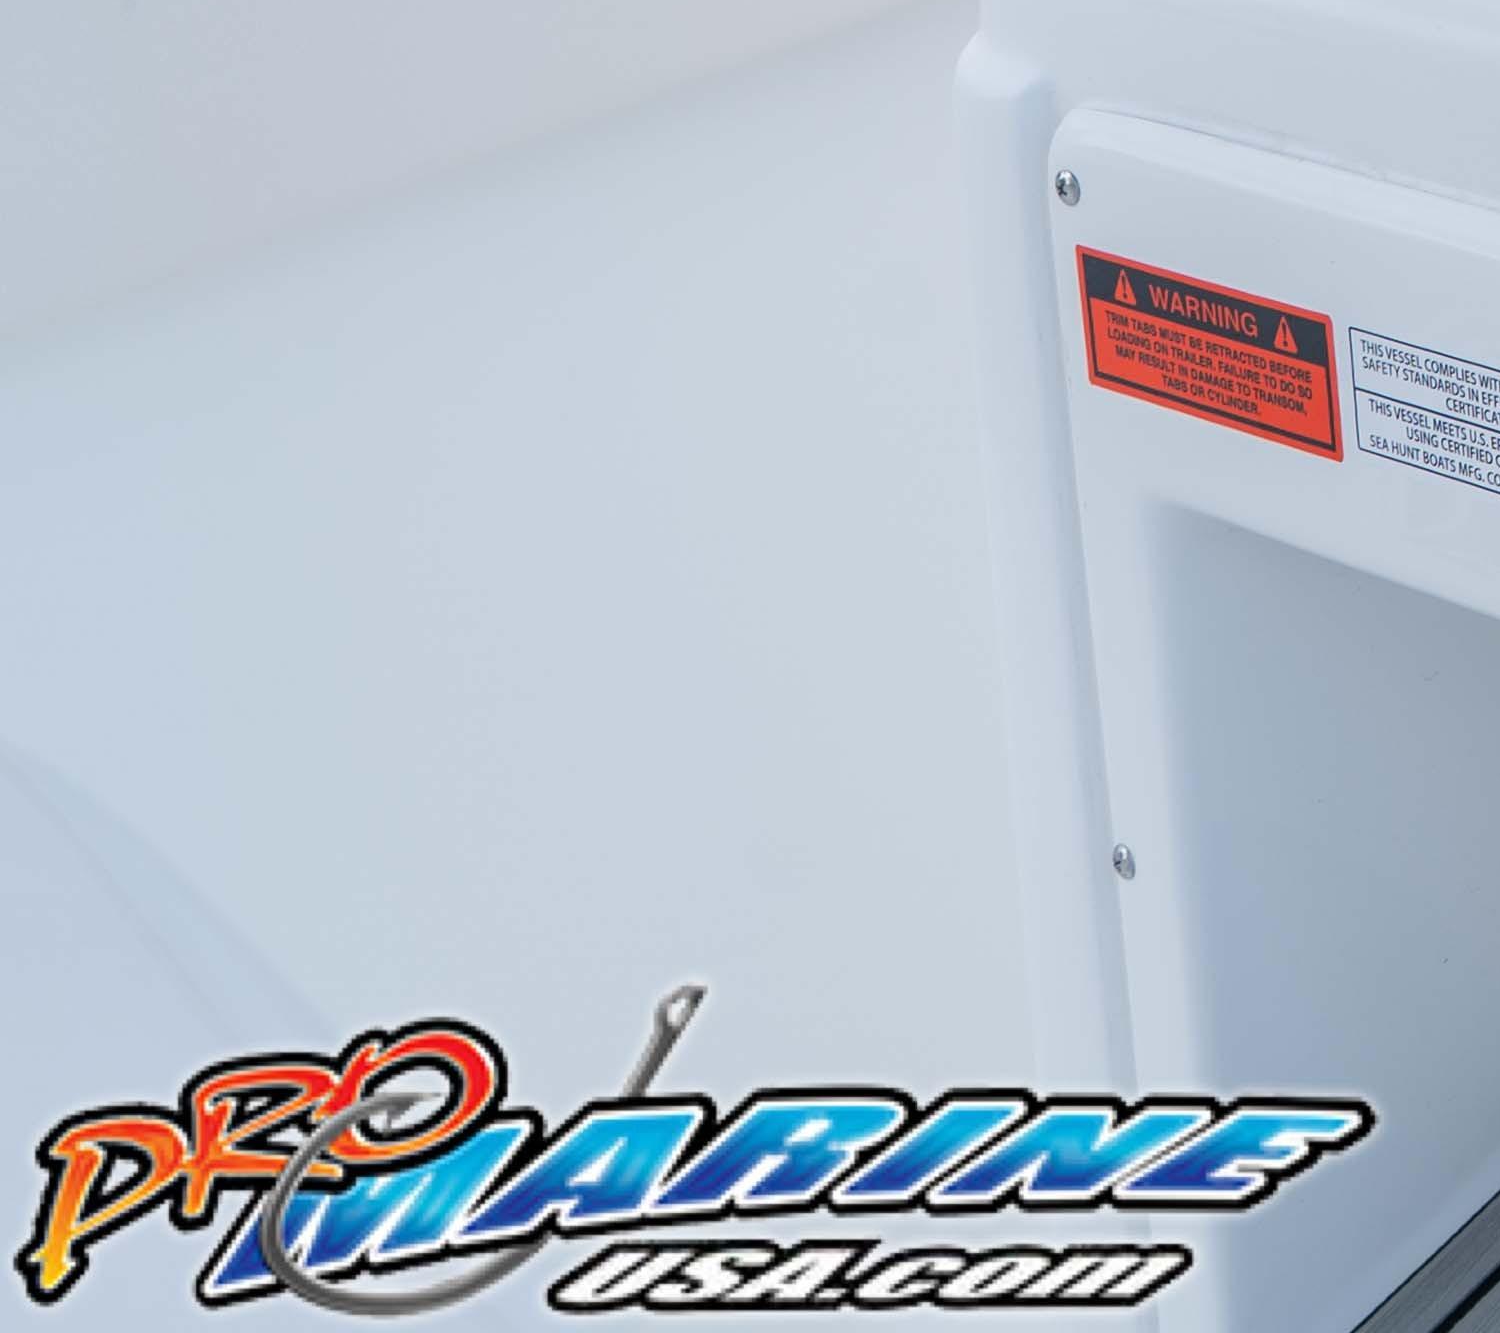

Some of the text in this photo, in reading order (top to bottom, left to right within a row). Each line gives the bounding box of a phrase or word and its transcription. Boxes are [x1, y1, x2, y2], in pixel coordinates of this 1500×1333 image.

[1148, 283, 1259, 338] WARNING
[1360, 338, 1383, 357] THIS
[1384, 346, 1422, 369] VESSEL
[1424, 358, 1476, 385] COMPLIES
[1361, 355, 1400, 377] SAFETY
[1402, 367, 1465, 398] STANDARDS
[1467, 387, 1478, 402] IN
[1368, 398, 1392, 417] THIS
[1393, 406, 1430, 429] VESSEL
[1432, 418, 1466, 440] MEETS
[1468, 429, 1489, 447] U.S.
[1406, 426, 1438, 448] USING
[1440, 437, 1493, 464] CERTIFIED
[1369, 434, 1389, 451] SEA
[1391, 440, 1419, 461] HUNT
[1422, 450, 1456, 472] BOATS
[1458, 461, 1484, 482] MFG.
